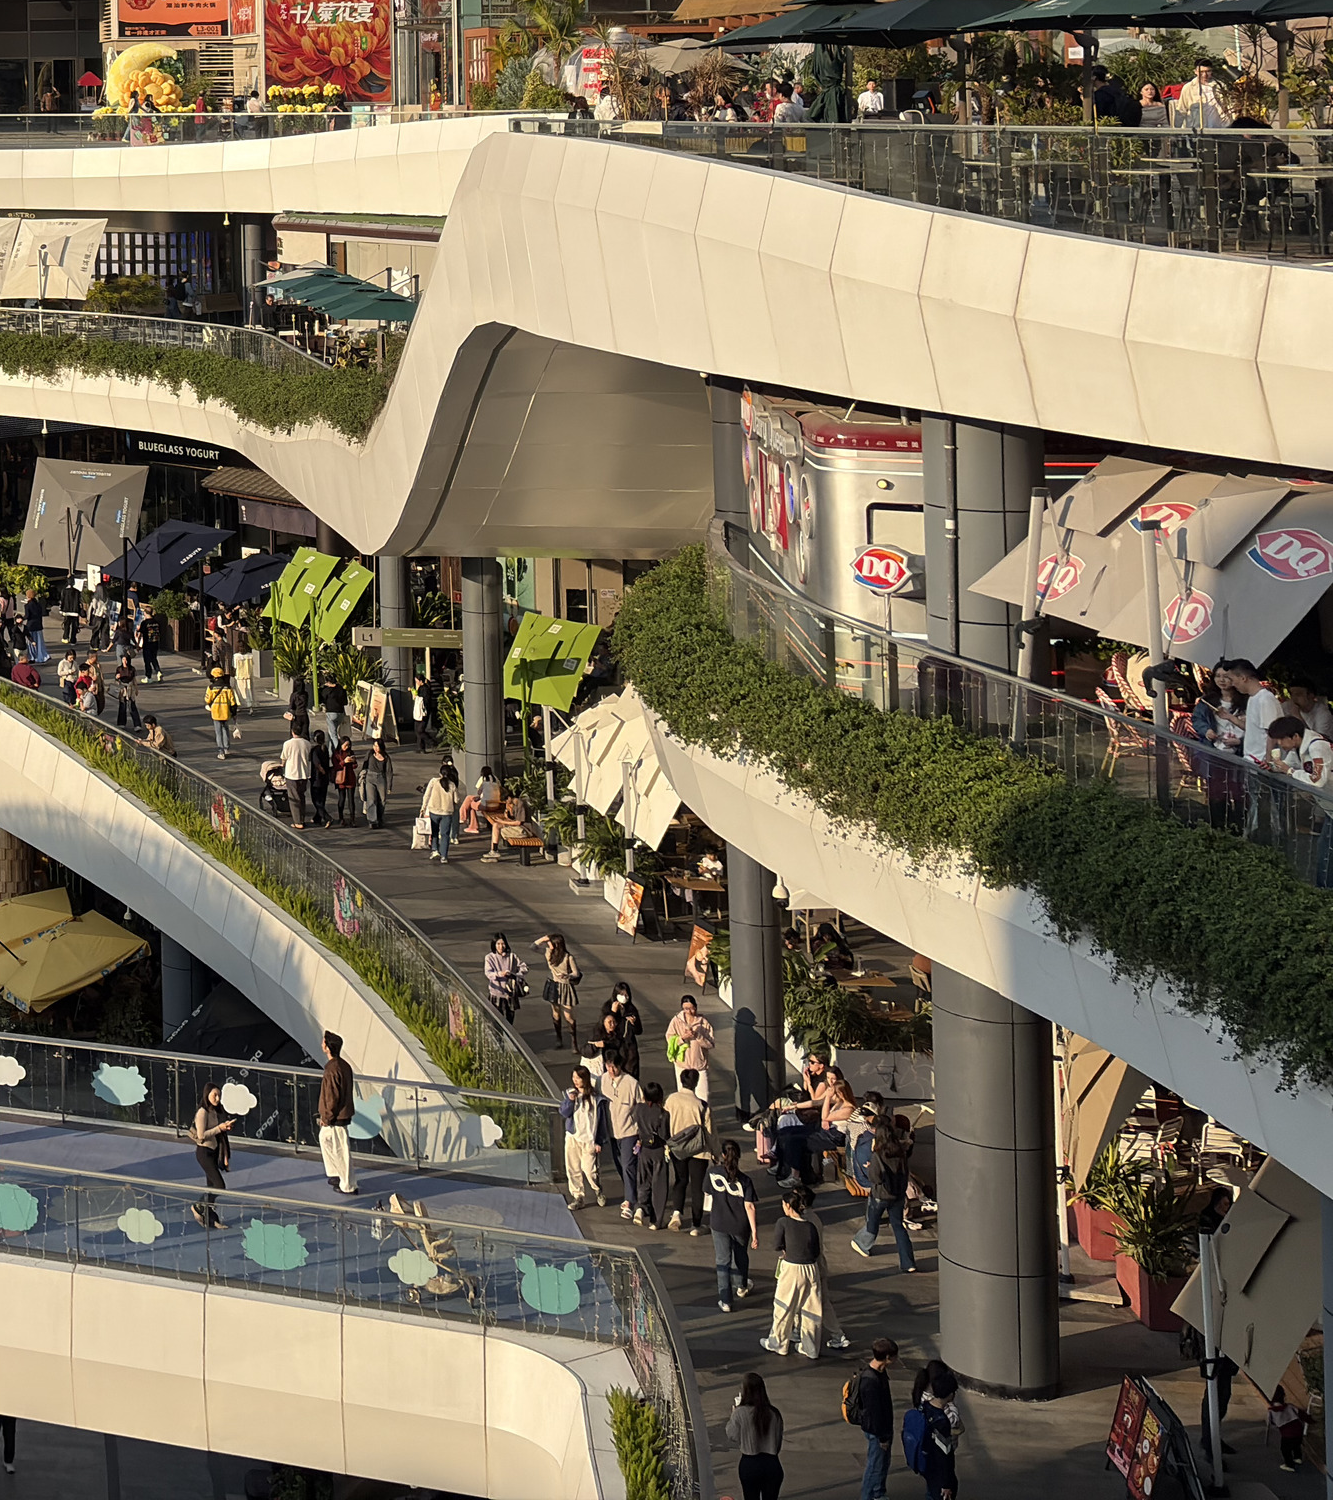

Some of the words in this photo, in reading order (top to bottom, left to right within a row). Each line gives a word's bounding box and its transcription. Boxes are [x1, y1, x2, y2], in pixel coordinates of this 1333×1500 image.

[138, 441, 183, 456] BLUEGLASS
[185, 447, 220, 461] YOGURT
[1263, 533, 1325, 577] DQ
[862, 555, 899, 583] DQ
[362, 633, 373, 641] L1
